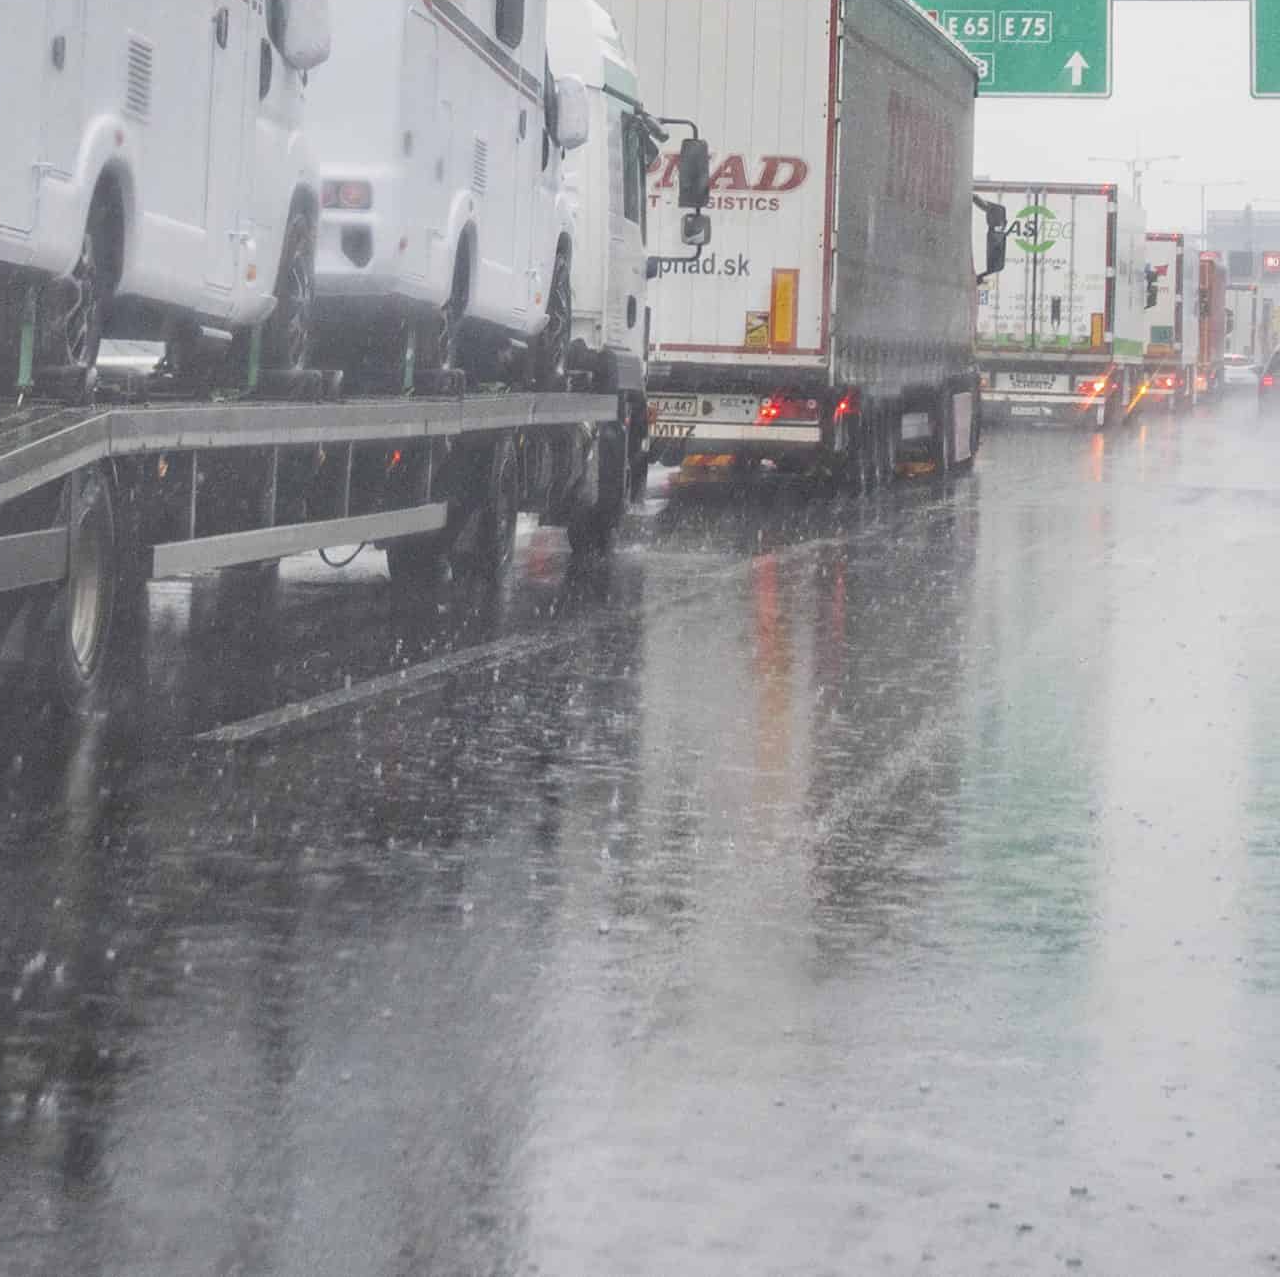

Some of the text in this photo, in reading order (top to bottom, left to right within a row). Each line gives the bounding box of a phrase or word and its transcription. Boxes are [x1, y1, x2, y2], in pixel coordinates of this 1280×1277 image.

[949, 17, 989, 37] E 65
[1004, 18, 1046, 37] E 75
[705, 196, 781, 212] GISTICS
